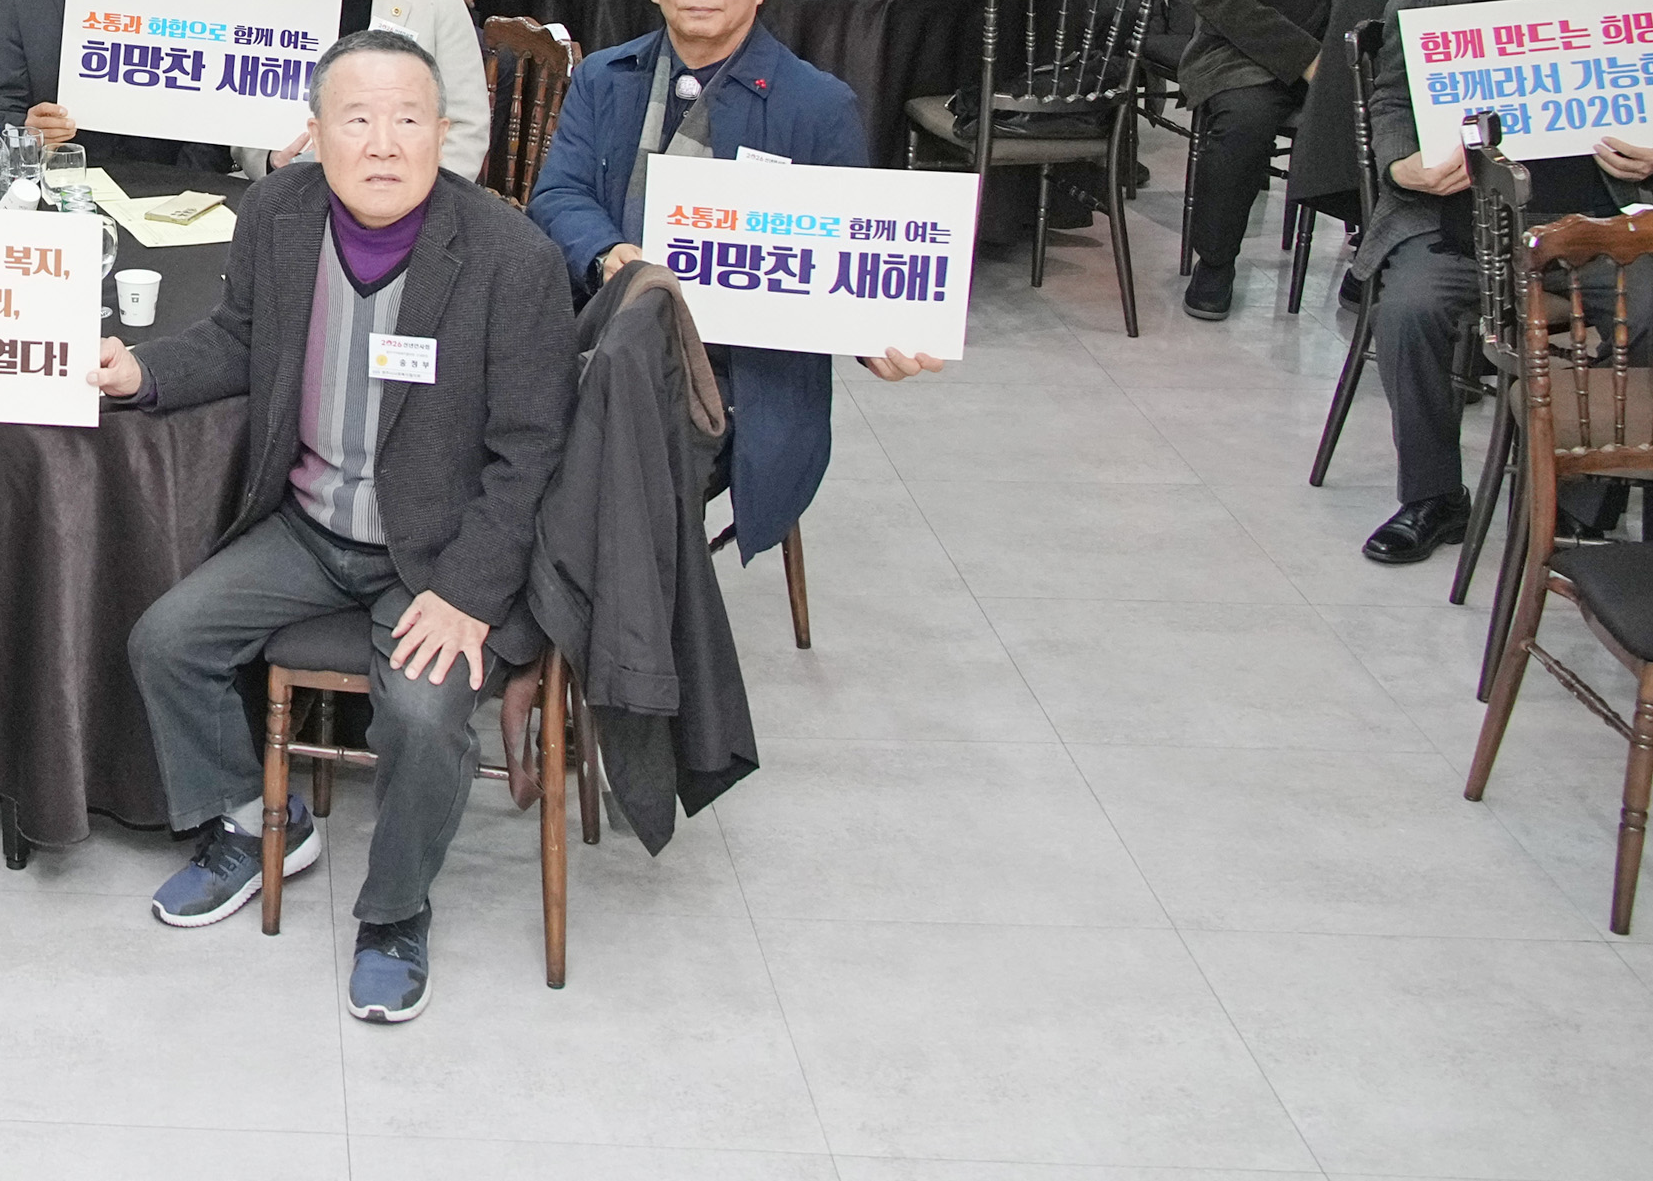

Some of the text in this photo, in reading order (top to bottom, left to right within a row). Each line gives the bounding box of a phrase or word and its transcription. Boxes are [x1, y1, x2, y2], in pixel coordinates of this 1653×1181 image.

[82, 11, 320, 51] 소통과 화합으로 함께 여는
[1419, 20, 1591, 63] 함께 만드는
[79, 40, 317, 102] 희망찬 새해!
[1426, 63, 1562, 105] 함께라서
[1541, 92, 1647, 132] 2026!
[667, 205, 951, 244] 소통과 화합으로 함께 여는
[4, 245, 70, 279] 복지,
[667, 237, 948, 301] 희망찬 새해!
